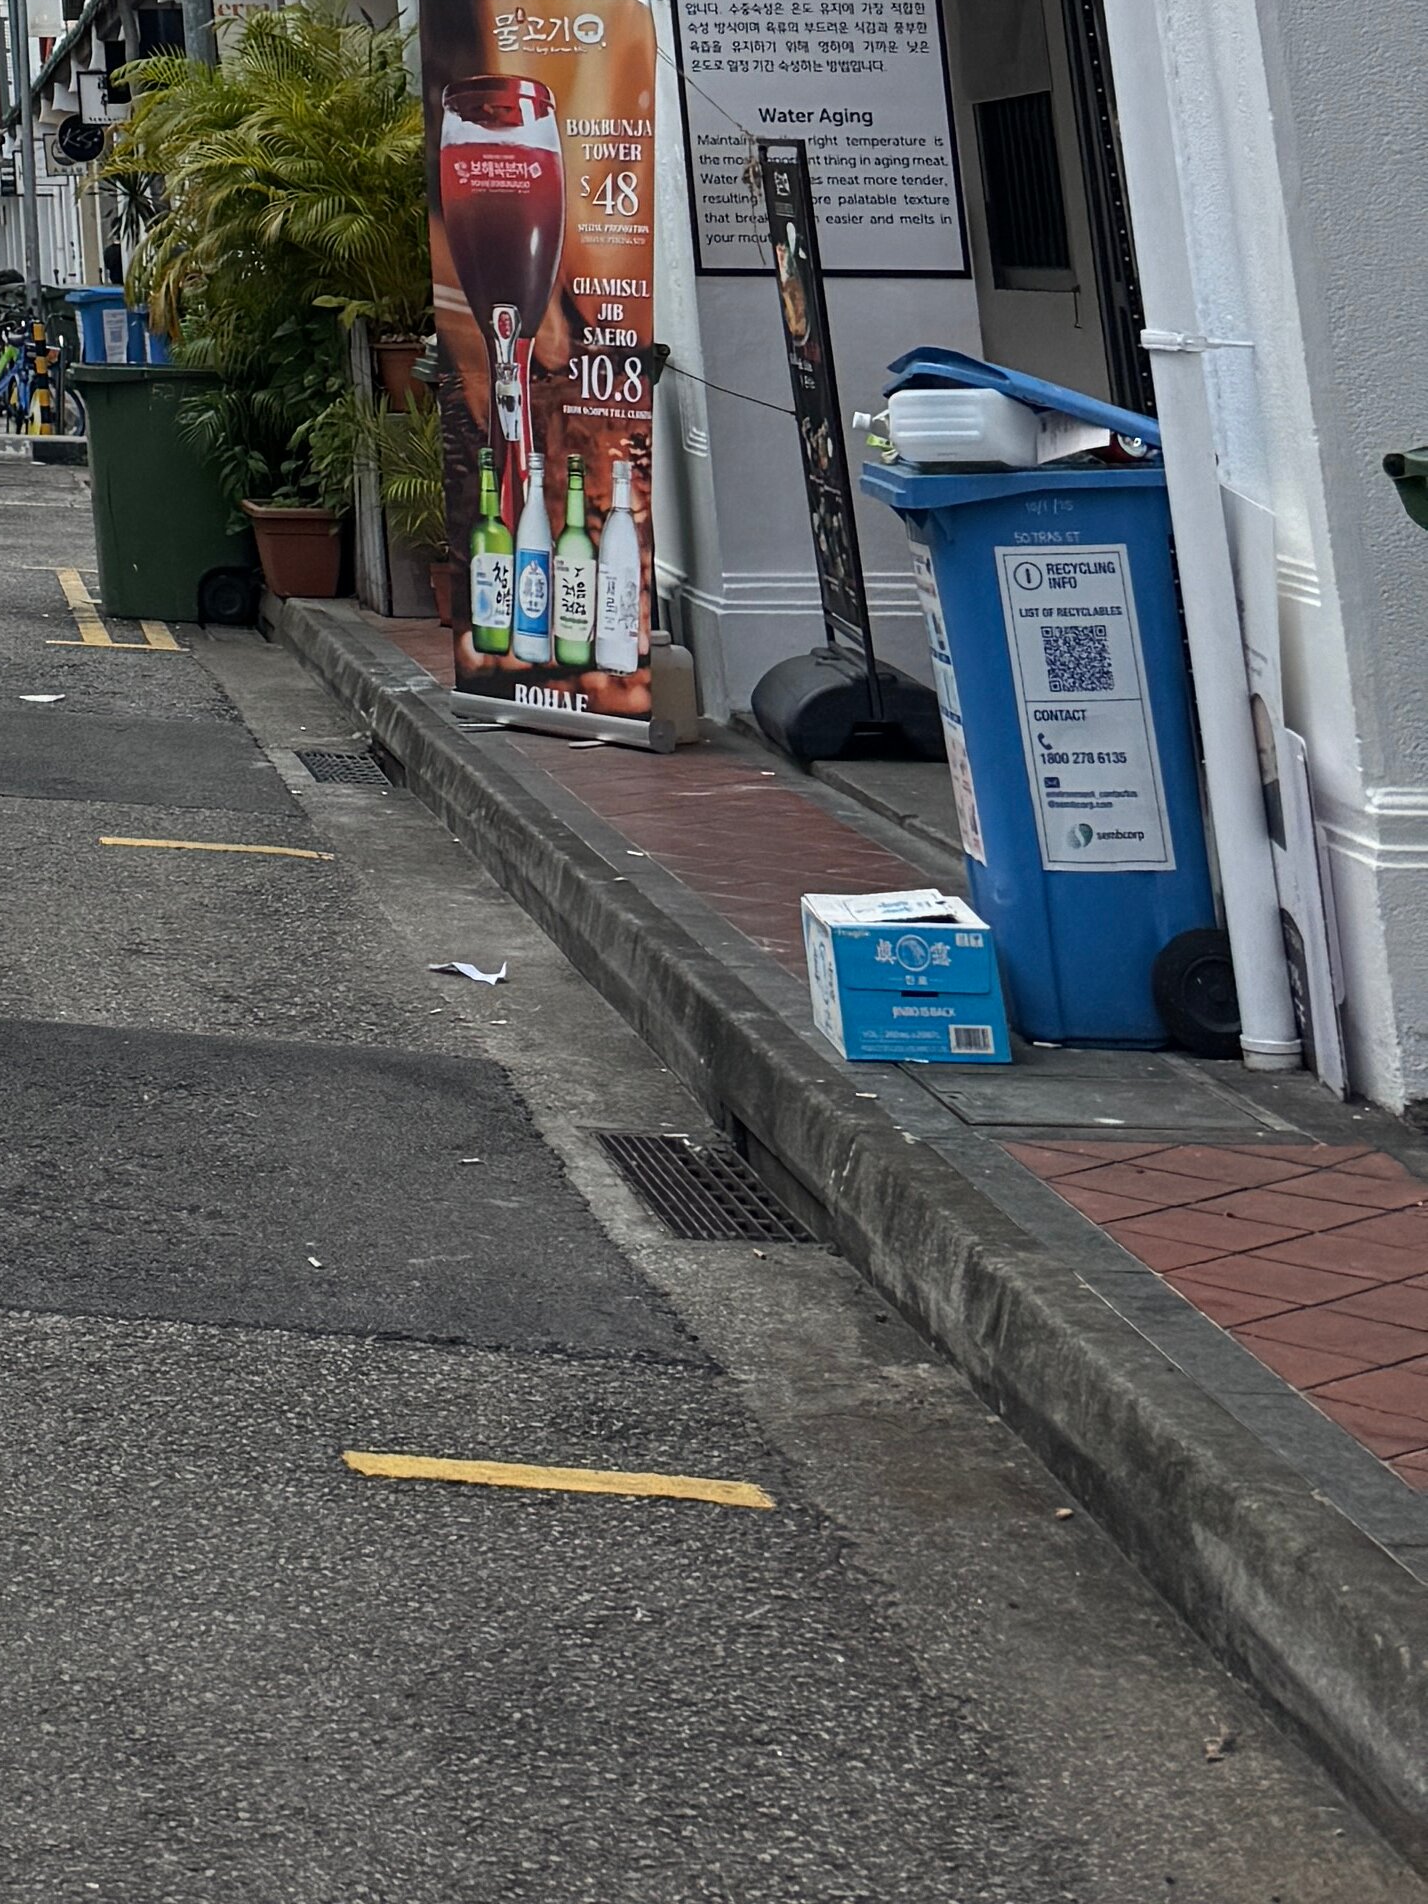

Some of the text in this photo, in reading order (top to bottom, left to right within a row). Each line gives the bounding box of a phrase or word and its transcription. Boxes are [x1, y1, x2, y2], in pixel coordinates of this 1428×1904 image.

[790, 2, 814, 15] 온도
[862, 2, 884, 15] 가장
[493, 13, 570, 52] 물고기
[688, 21, 709, 34] 숙성
[732, 40, 777, 53] 유지하기
[752, 59, 775, 72] 기간
[758, 107, 873, 127] Water Aging
[566, 119, 652, 137] BOKBUNJA
[808, 134, 838, 149] right
[846, 135, 927, 150] temperature
[934, 136, 944, 147] is
[581, 143, 642, 161] TOWER
[699, 154, 720, 166] the
[824, 155, 857, 169] thing
[859, 155, 871, 166] in
[874, 155, 910, 169] aging
[912, 156, 948, 167] meat.
[700, 173, 738, 185] Water
[827, 175, 860, 186] meat
[863, 176, 898, 186] more
[702, 193, 950, 207] resulting ore palatable texture
[704, 213, 731, 224] that
[825, 214, 864, 225] easier
[869, 213, 894, 224] and
[899, 214, 935, 225] melts
[940, 214, 953, 225] in
[705, 233, 735, 245] your
[573, 277, 650, 298] CHAMISUL
[597, 303, 624, 321] JIB
[583, 327, 638, 347] SAERO
[1031, 531, 1063, 543] TRAS
[1065, 531, 1081, 542] ST
[1045, 561, 1116, 576] RECYCLING
[1048, 576, 1078, 590] INFO
[1019, 605, 1123, 618] LIST OF RECYCLABLES
[1034, 709, 1087, 722] CONTACT
[1040, 751, 1128, 765] 1800 278 6135
[1096, 829, 1145, 842] sembcorp
